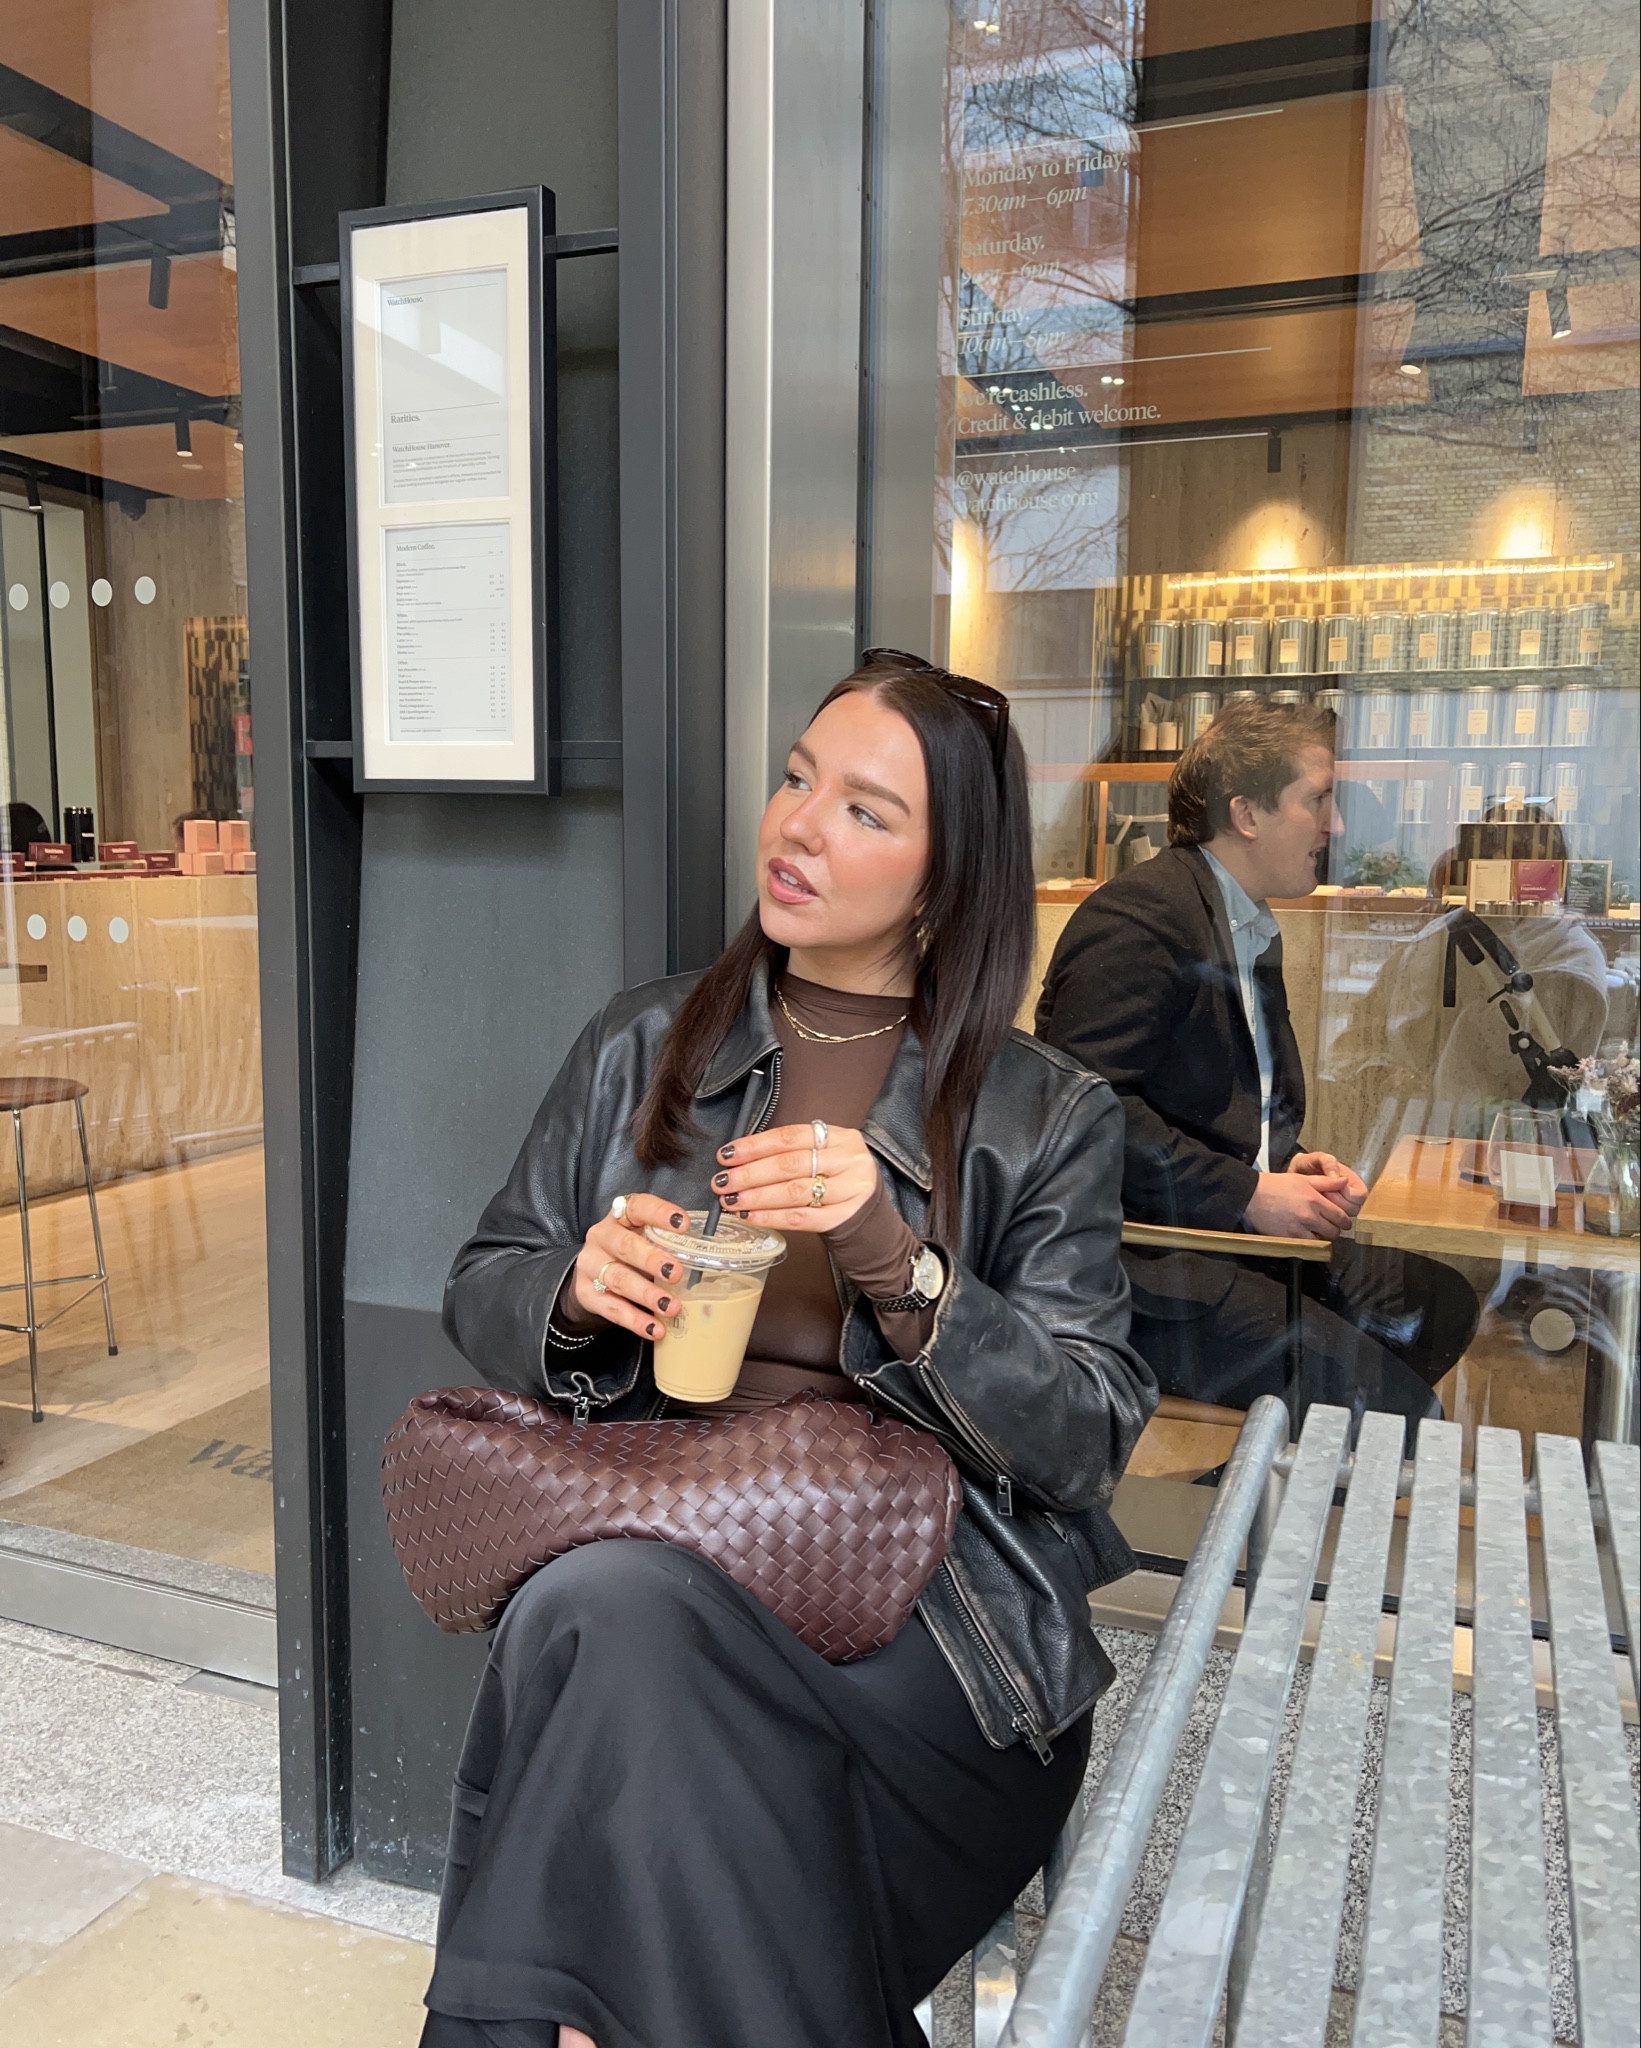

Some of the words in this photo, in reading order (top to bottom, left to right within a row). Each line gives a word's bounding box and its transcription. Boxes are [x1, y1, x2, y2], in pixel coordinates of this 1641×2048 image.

[962, 164, 1038, 188] Monday
[1041, 161, 1060, 178] to
[1064, 151, 1128, 175] Friday.
[961, 232, 1046, 258] Saturday.
[960, 308, 1030, 327] Sunday.
[1008, 381, 1089, 403] cashless.
[390, 413, 421, 424] Rarities.
[957, 413, 1009, 434] Credit
[1012, 412, 1028, 430] &
[1030, 408, 1074, 428] debit
[1078, 403, 1162, 425] welcome.
[956, 464, 1077, 489] @watchhouse
[189, 1438, 273, 1482] Wa
